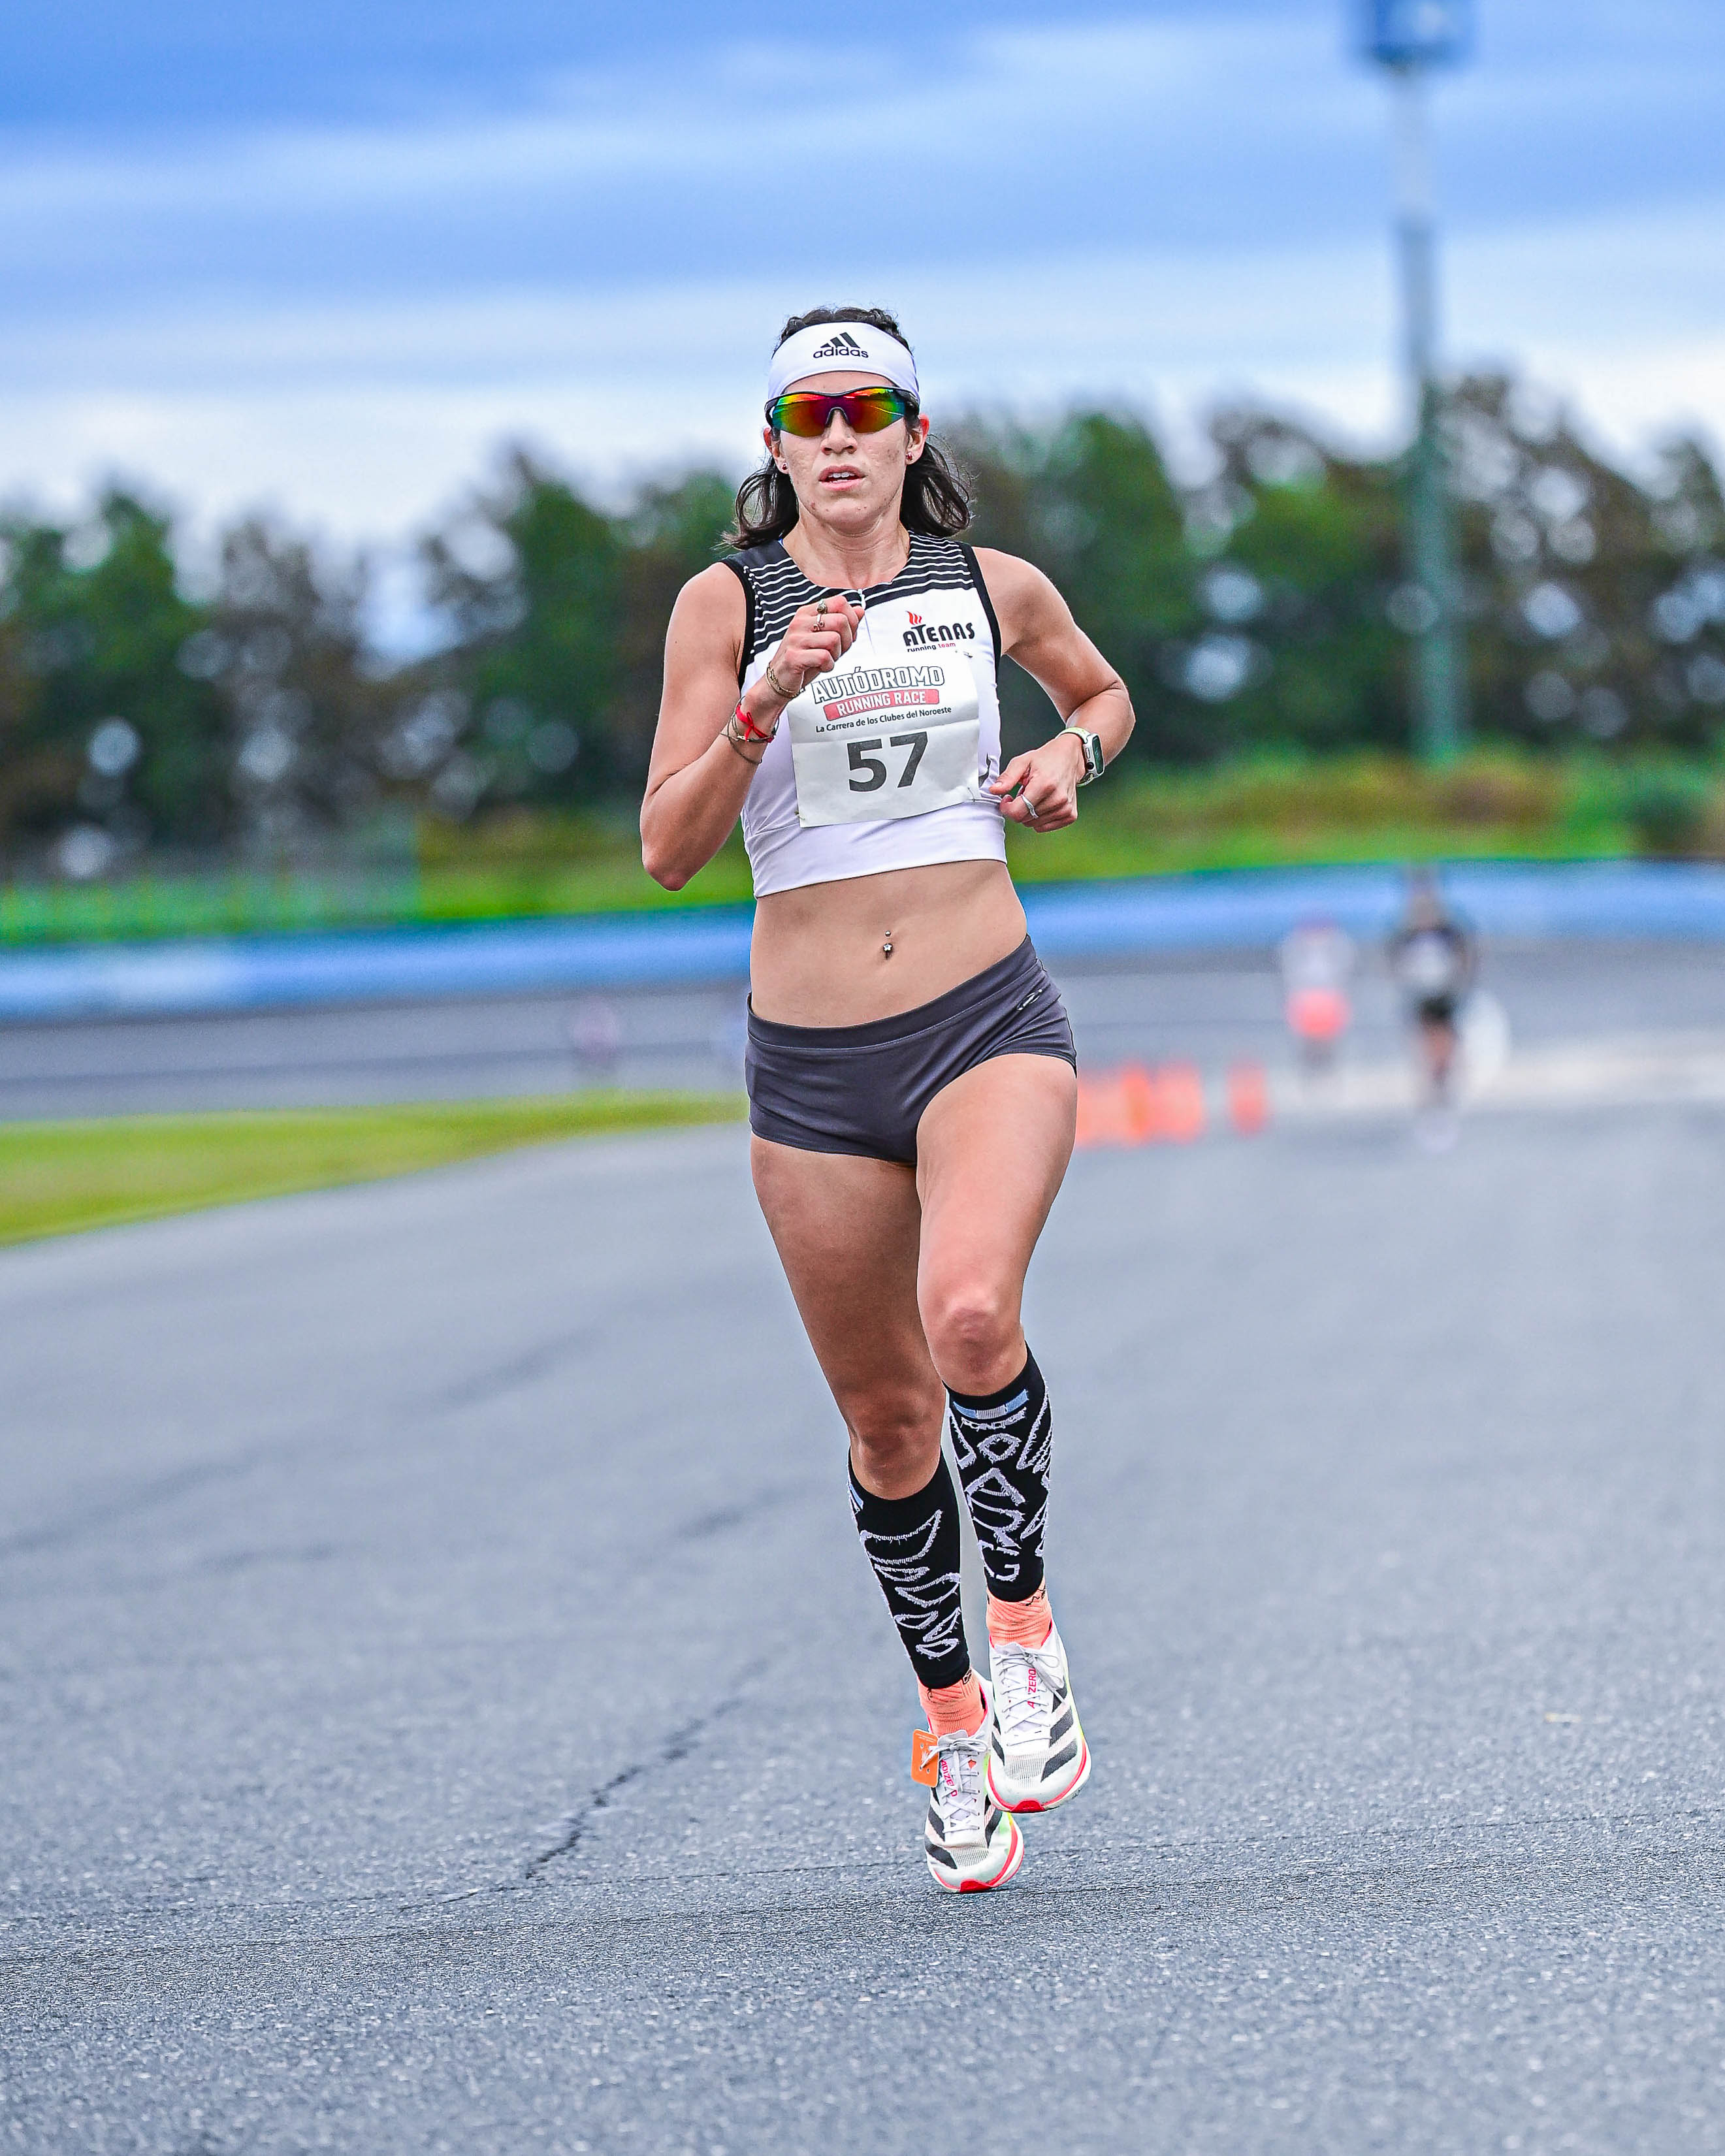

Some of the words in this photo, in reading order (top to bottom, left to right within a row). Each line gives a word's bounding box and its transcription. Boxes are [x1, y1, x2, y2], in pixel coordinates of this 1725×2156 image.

[813, 347, 869, 359] adidas
[903, 622, 975, 647] ATENAS
[811, 666, 945, 704] AUTÓDROMO
[836, 694, 891, 716] RUNNING
[893, 691, 926, 705] RACE
[826, 721, 854, 732] Carrera
[856, 718, 866, 727] de
[879, 714, 905, 723] Clubes
[906, 710, 918, 719] del
[918, 707, 952, 716] Noroeste
[846, 732, 928, 792] 57
[1027, 1667, 1037, 1709] AZERO
[941, 1759, 958, 1797] ADIZEO
